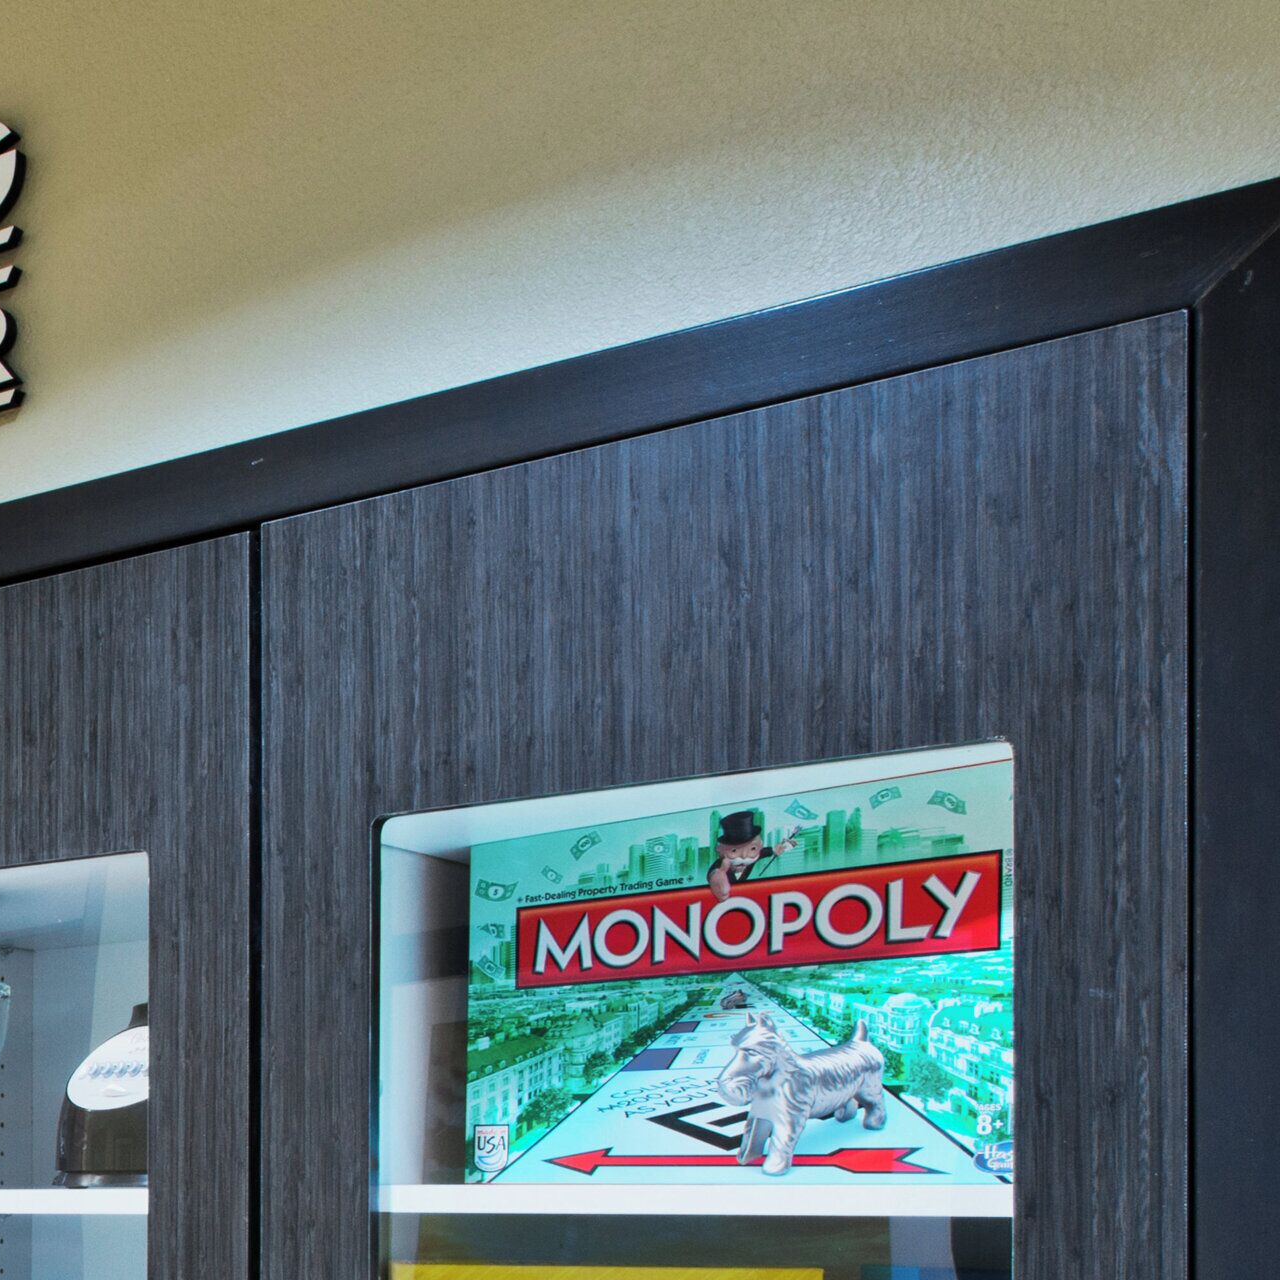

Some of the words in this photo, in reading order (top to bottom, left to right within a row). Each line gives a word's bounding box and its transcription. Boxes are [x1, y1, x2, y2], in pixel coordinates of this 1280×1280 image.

[525, 887, 576, 904] Fast-Dealing
[578, 884, 618, 898] Property
[620, 881, 653, 892] Trading
[656, 877, 684, 887] Game
[532, 869, 982, 974] MONOPOLY
[610, 1075, 699, 1100] COLLECT
[976, 1114, 1004, 1135] 8+
[477, 1135, 506, 1153] USA
